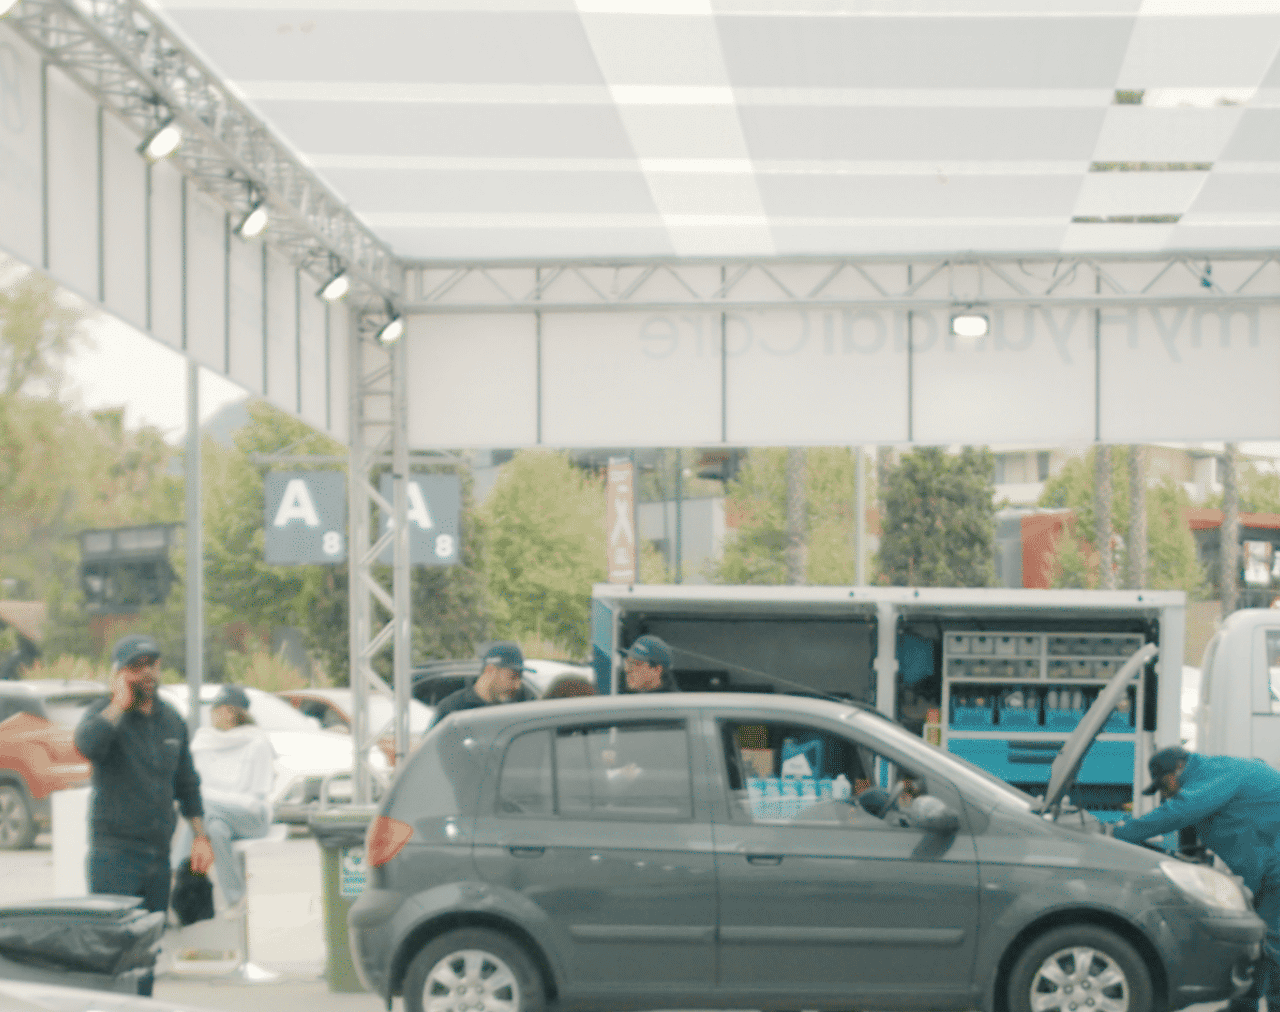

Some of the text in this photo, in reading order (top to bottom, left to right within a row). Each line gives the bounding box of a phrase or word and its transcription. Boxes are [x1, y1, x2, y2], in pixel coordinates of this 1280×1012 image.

[273, 478, 321, 527] A
[322, 531, 342, 555] 8
[434, 533, 454, 558] 8
